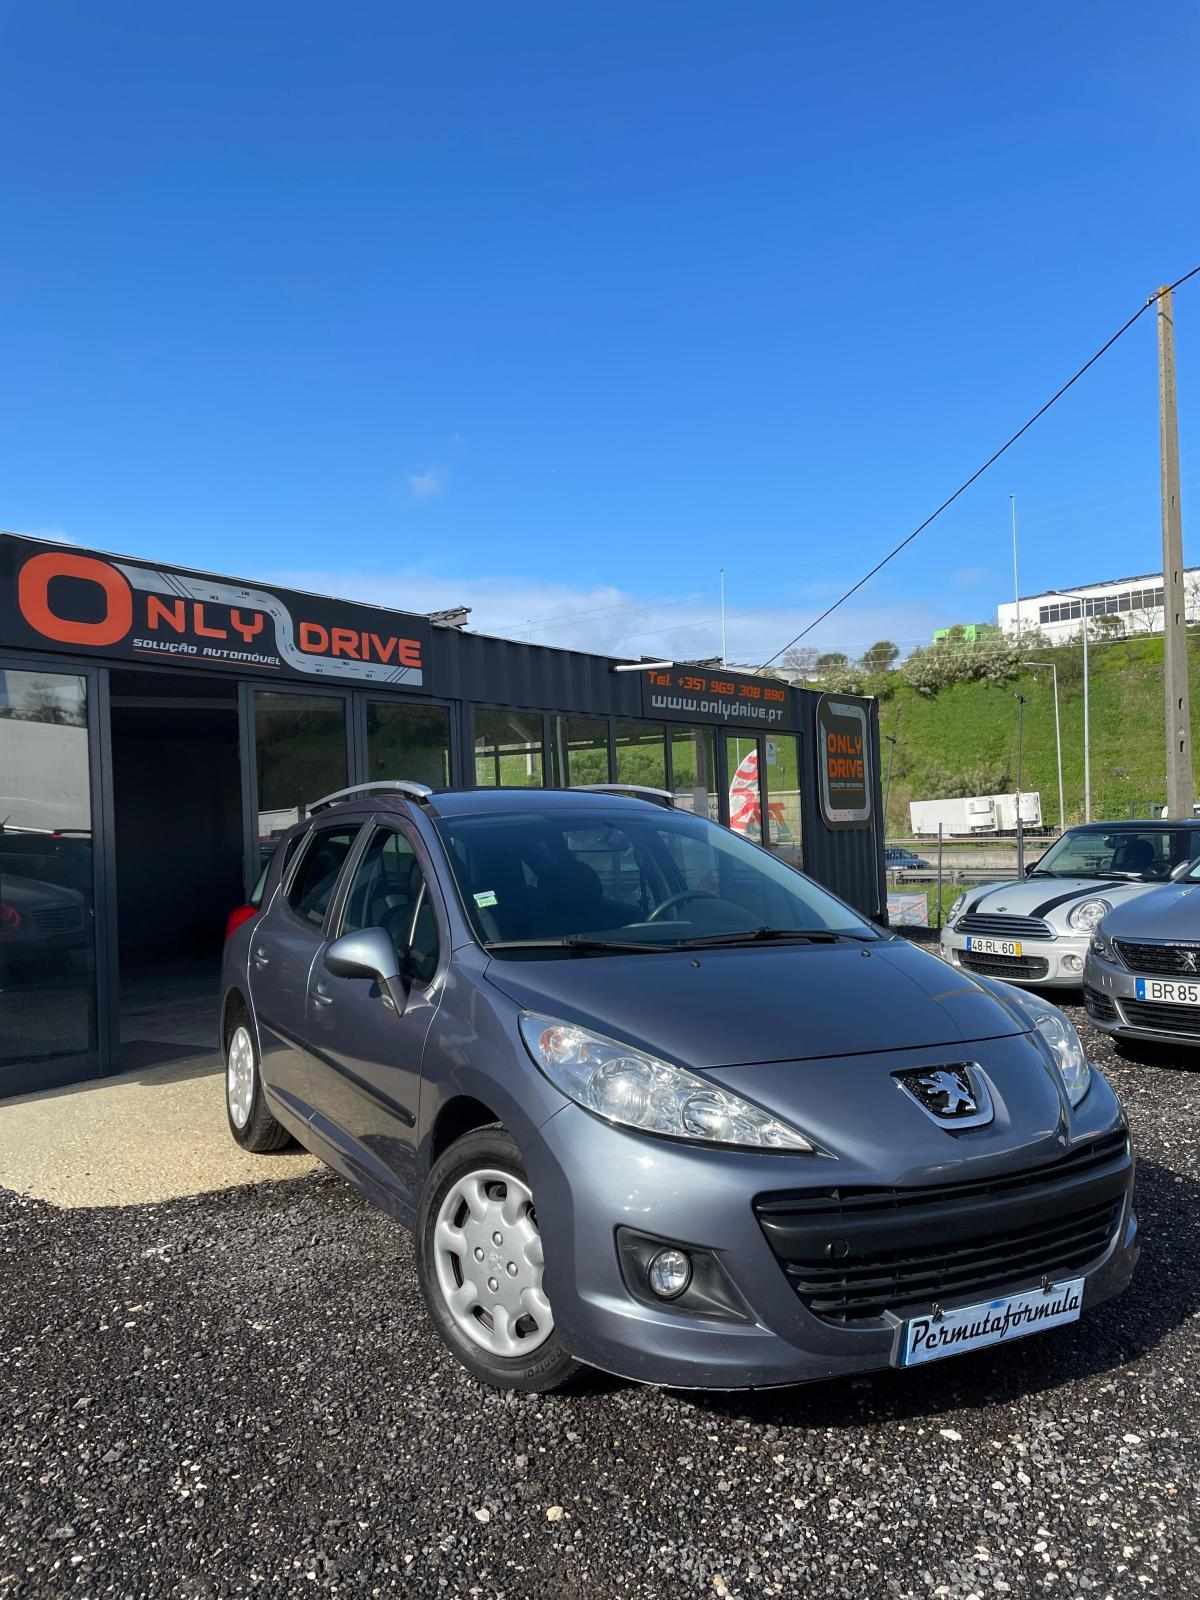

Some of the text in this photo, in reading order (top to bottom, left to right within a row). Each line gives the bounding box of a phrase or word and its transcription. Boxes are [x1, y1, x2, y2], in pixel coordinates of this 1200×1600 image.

[18, 551, 422, 668] ONLY DRIVE
[132, 638, 281, 666] SOLUÇÃO AUTOMÓVEL
[678, 677, 705, 691] +351
[827, 733, 863, 754] ONLY
[828, 758, 865, 778] DRIVE
[1151, 982, 1175, 1001] BR
[1177, 985, 1198, 1002] 85
[911, 1287, 1080, 1353] Permutafórmula
